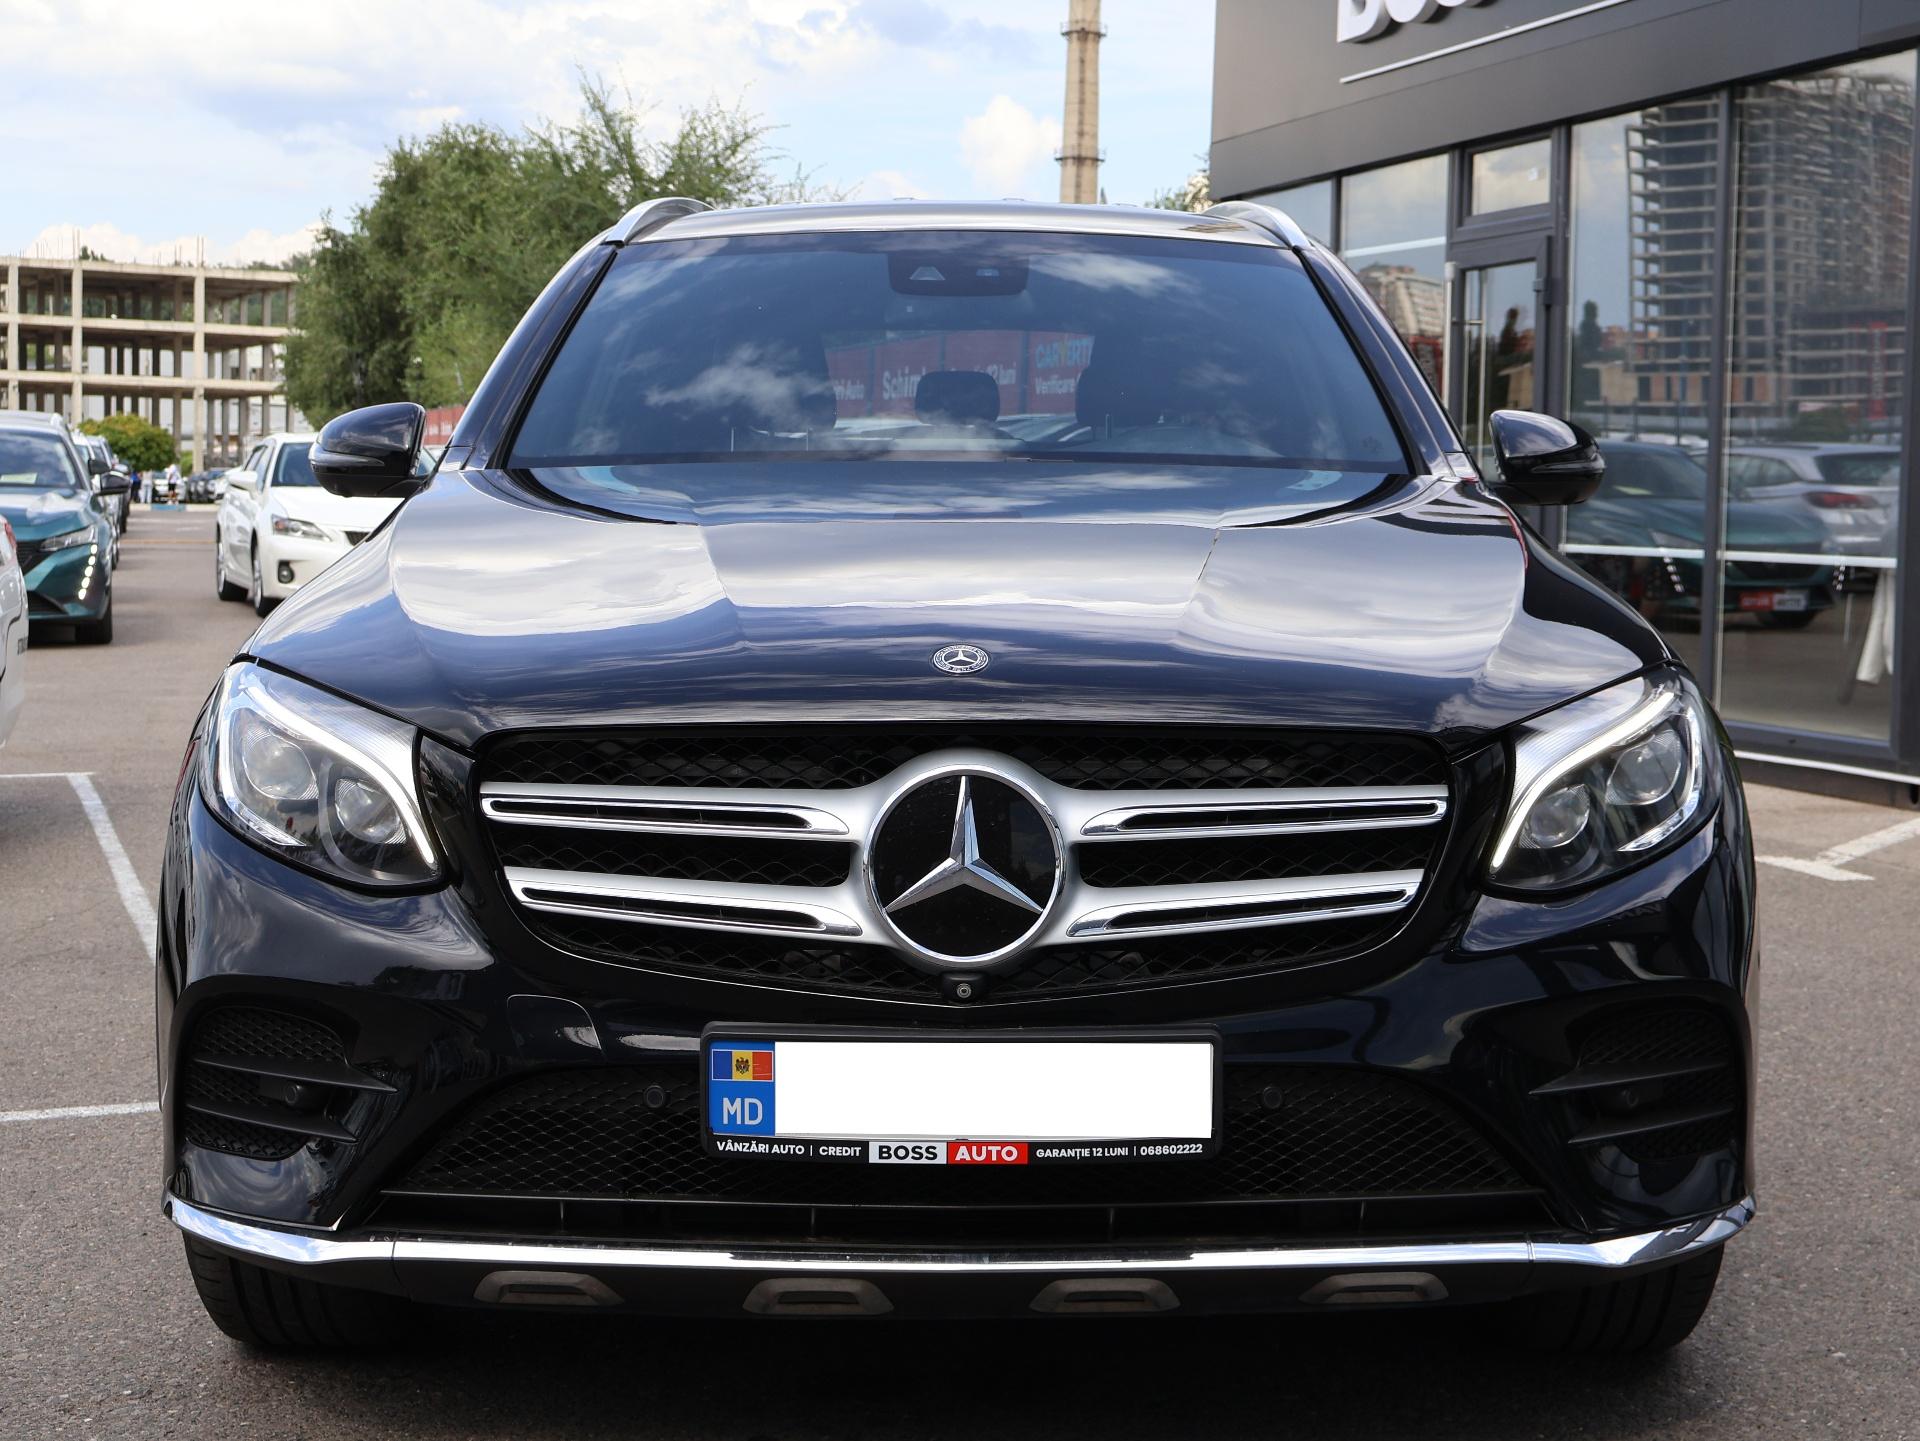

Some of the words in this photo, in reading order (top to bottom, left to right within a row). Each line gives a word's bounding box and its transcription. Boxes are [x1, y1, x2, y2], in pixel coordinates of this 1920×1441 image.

[882, 366, 926, 400] Schim
[722, 1097, 763, 1125] MD
[716, 1140, 770, 1154] VÂNZĂRI
[771, 1144, 805, 1155] AUTO
[819, 1146, 862, 1157] CREDIT
[878, 1144, 938, 1161] BOSS
[954, 1145, 1018, 1161] AUTO
[1036, 1148, 1091, 1160] GARANȚIE
[1092, 1148, 1103, 1157] 12
[1104, 1147, 1129, 1157] LUNI
[1140, 1143, 1203, 1157] 068602222
